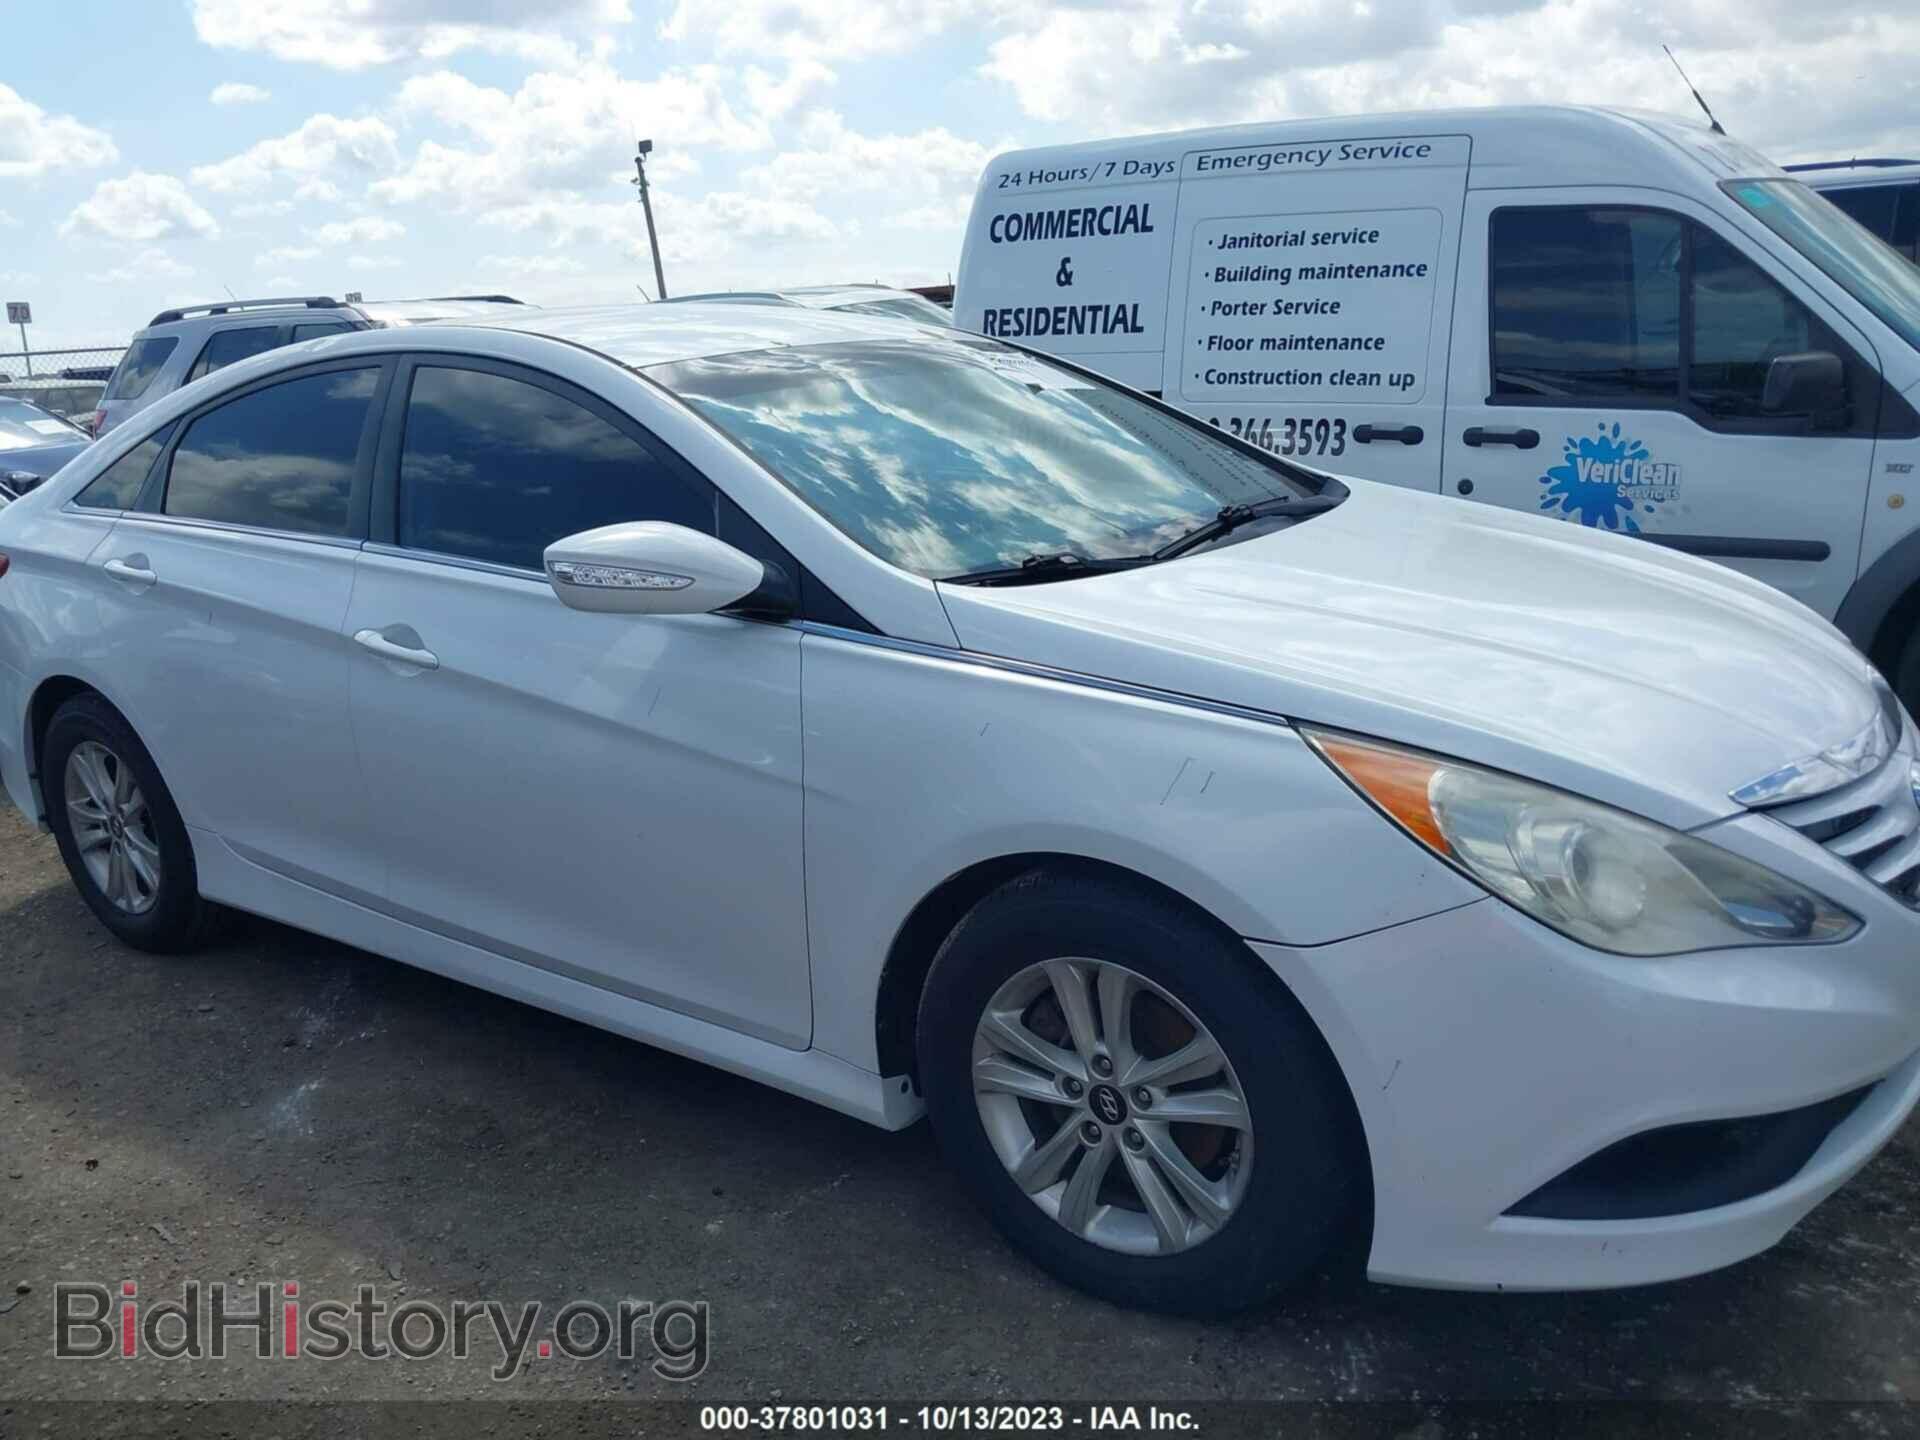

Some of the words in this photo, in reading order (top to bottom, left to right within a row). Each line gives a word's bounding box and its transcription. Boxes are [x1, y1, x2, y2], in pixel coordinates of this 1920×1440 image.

[998, 174, 1022, 189] 24
[1123, 159, 1176, 178] Days
[1196, 148, 1332, 171] Emergency
[1338, 141, 1431, 161] Service
[990, 203, 1153, 243] COMMERCIAL
[1217, 230, 1305, 249] Janitorial
[1311, 227, 1379, 246] service
[1056, 256, 1073, 287] &
[1214, 265, 1292, 285] Building
[1298, 263, 1428, 281] maintenance
[1211, 300, 1267, 316] Porter
[1273, 298, 1341, 316] Service
[983, 303, 1144, 337] RESIDENTIAL
[1207, 335, 1254, 351] Floor
[1260, 335, 1385, 351] maintenance
[1204, 368, 1322, 385] Construction
[1329, 369, 1381, 386] clean
[1389, 373, 1415, 391] up
[1577, 456, 1681, 485] VeriClean
[1617, 484, 1680, 500] Services
